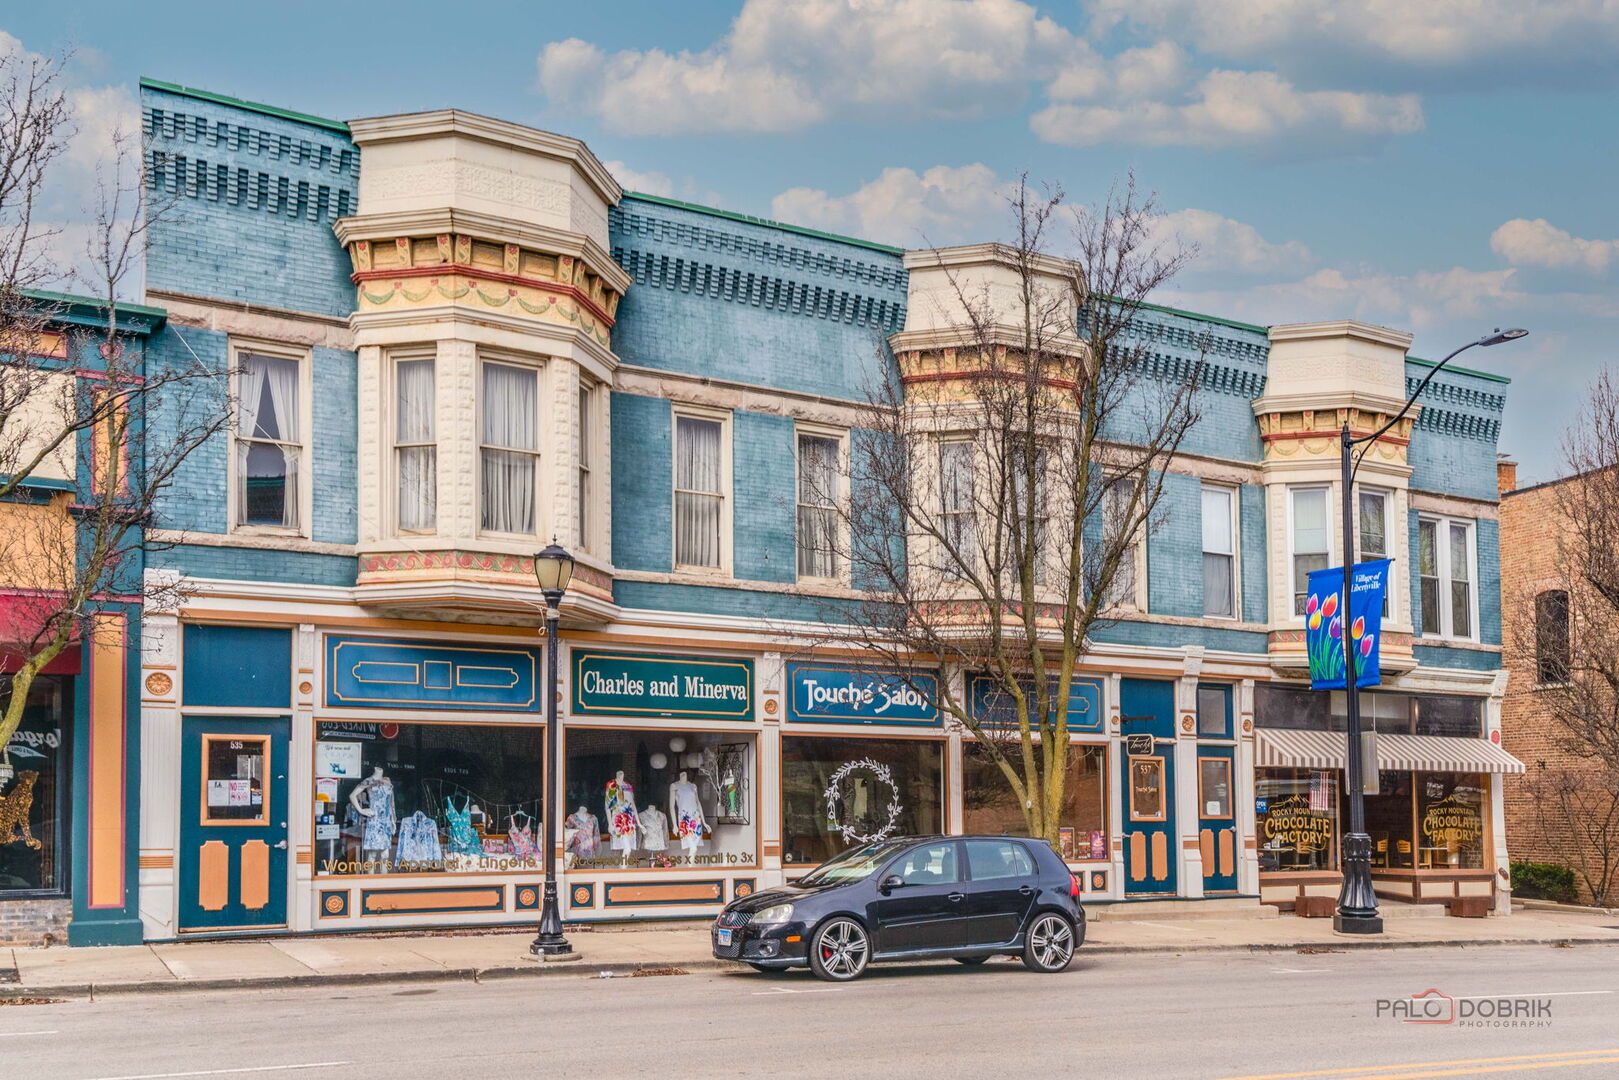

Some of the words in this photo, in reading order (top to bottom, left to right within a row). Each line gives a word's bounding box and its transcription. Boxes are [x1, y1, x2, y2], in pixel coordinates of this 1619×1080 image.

[1355, 574, 1373, 583] Village
[583, 670, 644, 697] Charles
[650, 675, 679, 698] and
[684, 676, 747, 700] Minerva
[803, 680, 874, 711] Touché
[874, 683, 929, 714] Salon
[230, 741, 243, 749] 535
[1140, 765, 1151, 774] 537
[1272, 808, 1292, 817] ROCKY
[1429, 808, 1447, 816] ROCKY
[1448, 807, 1475, 816] MOUNTAIN
[1264, 817, 1332, 839] CHOCOLATE
[1423, 816, 1482, 836] CHOCOLATE
[684, 856, 692, 864] x
[694, 853, 723, 865] small
[726, 853, 737, 863] to
[740, 852, 754, 863] 3x
[323, 859, 393, 872] Women's
